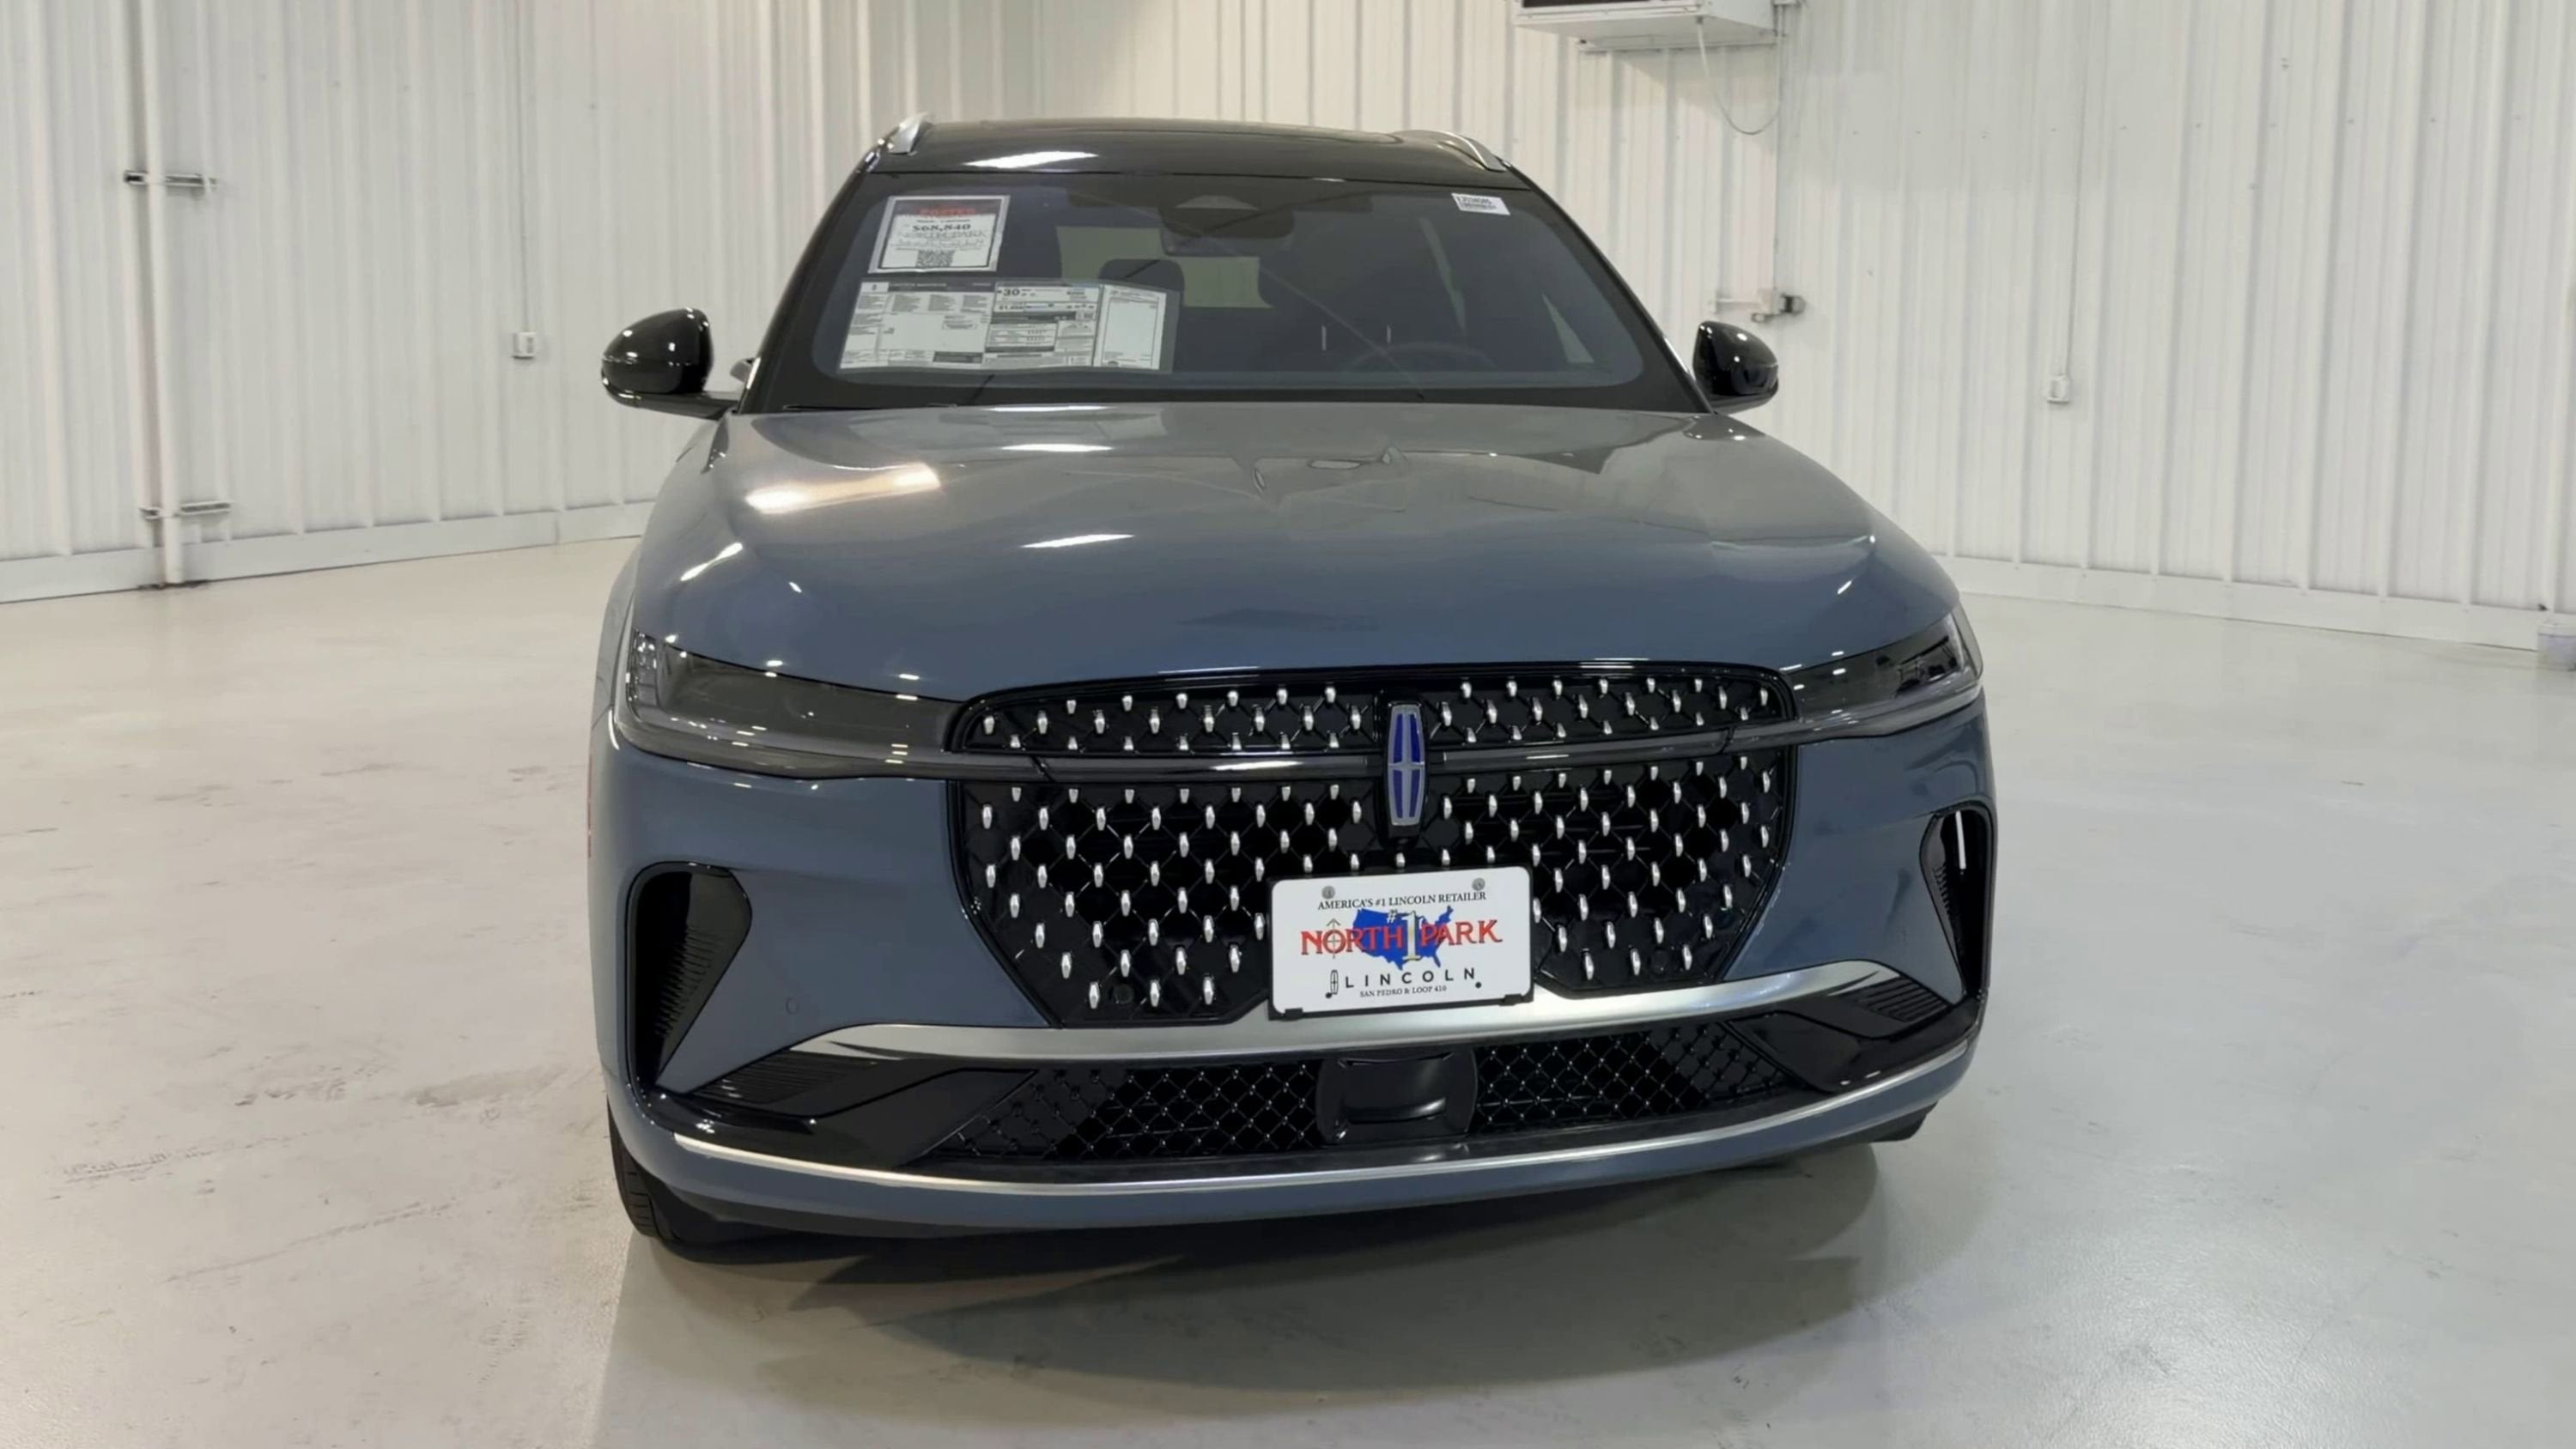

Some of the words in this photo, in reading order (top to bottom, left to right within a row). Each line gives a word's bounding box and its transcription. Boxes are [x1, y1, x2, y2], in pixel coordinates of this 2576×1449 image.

[1317, 898, 1374, 910] AMERICA'S
[1376, 898, 1386, 906] #1
[1388, 894, 1437, 906] LINCOLN
[1438, 891, 1486, 904] RETAILER
[1300, 925, 1404, 955] NORTH
[1419, 919, 1504, 948] PARK
[1346, 967, 1475, 988] LINCOLN
[1412, 985, 1433, 994] LOOP
